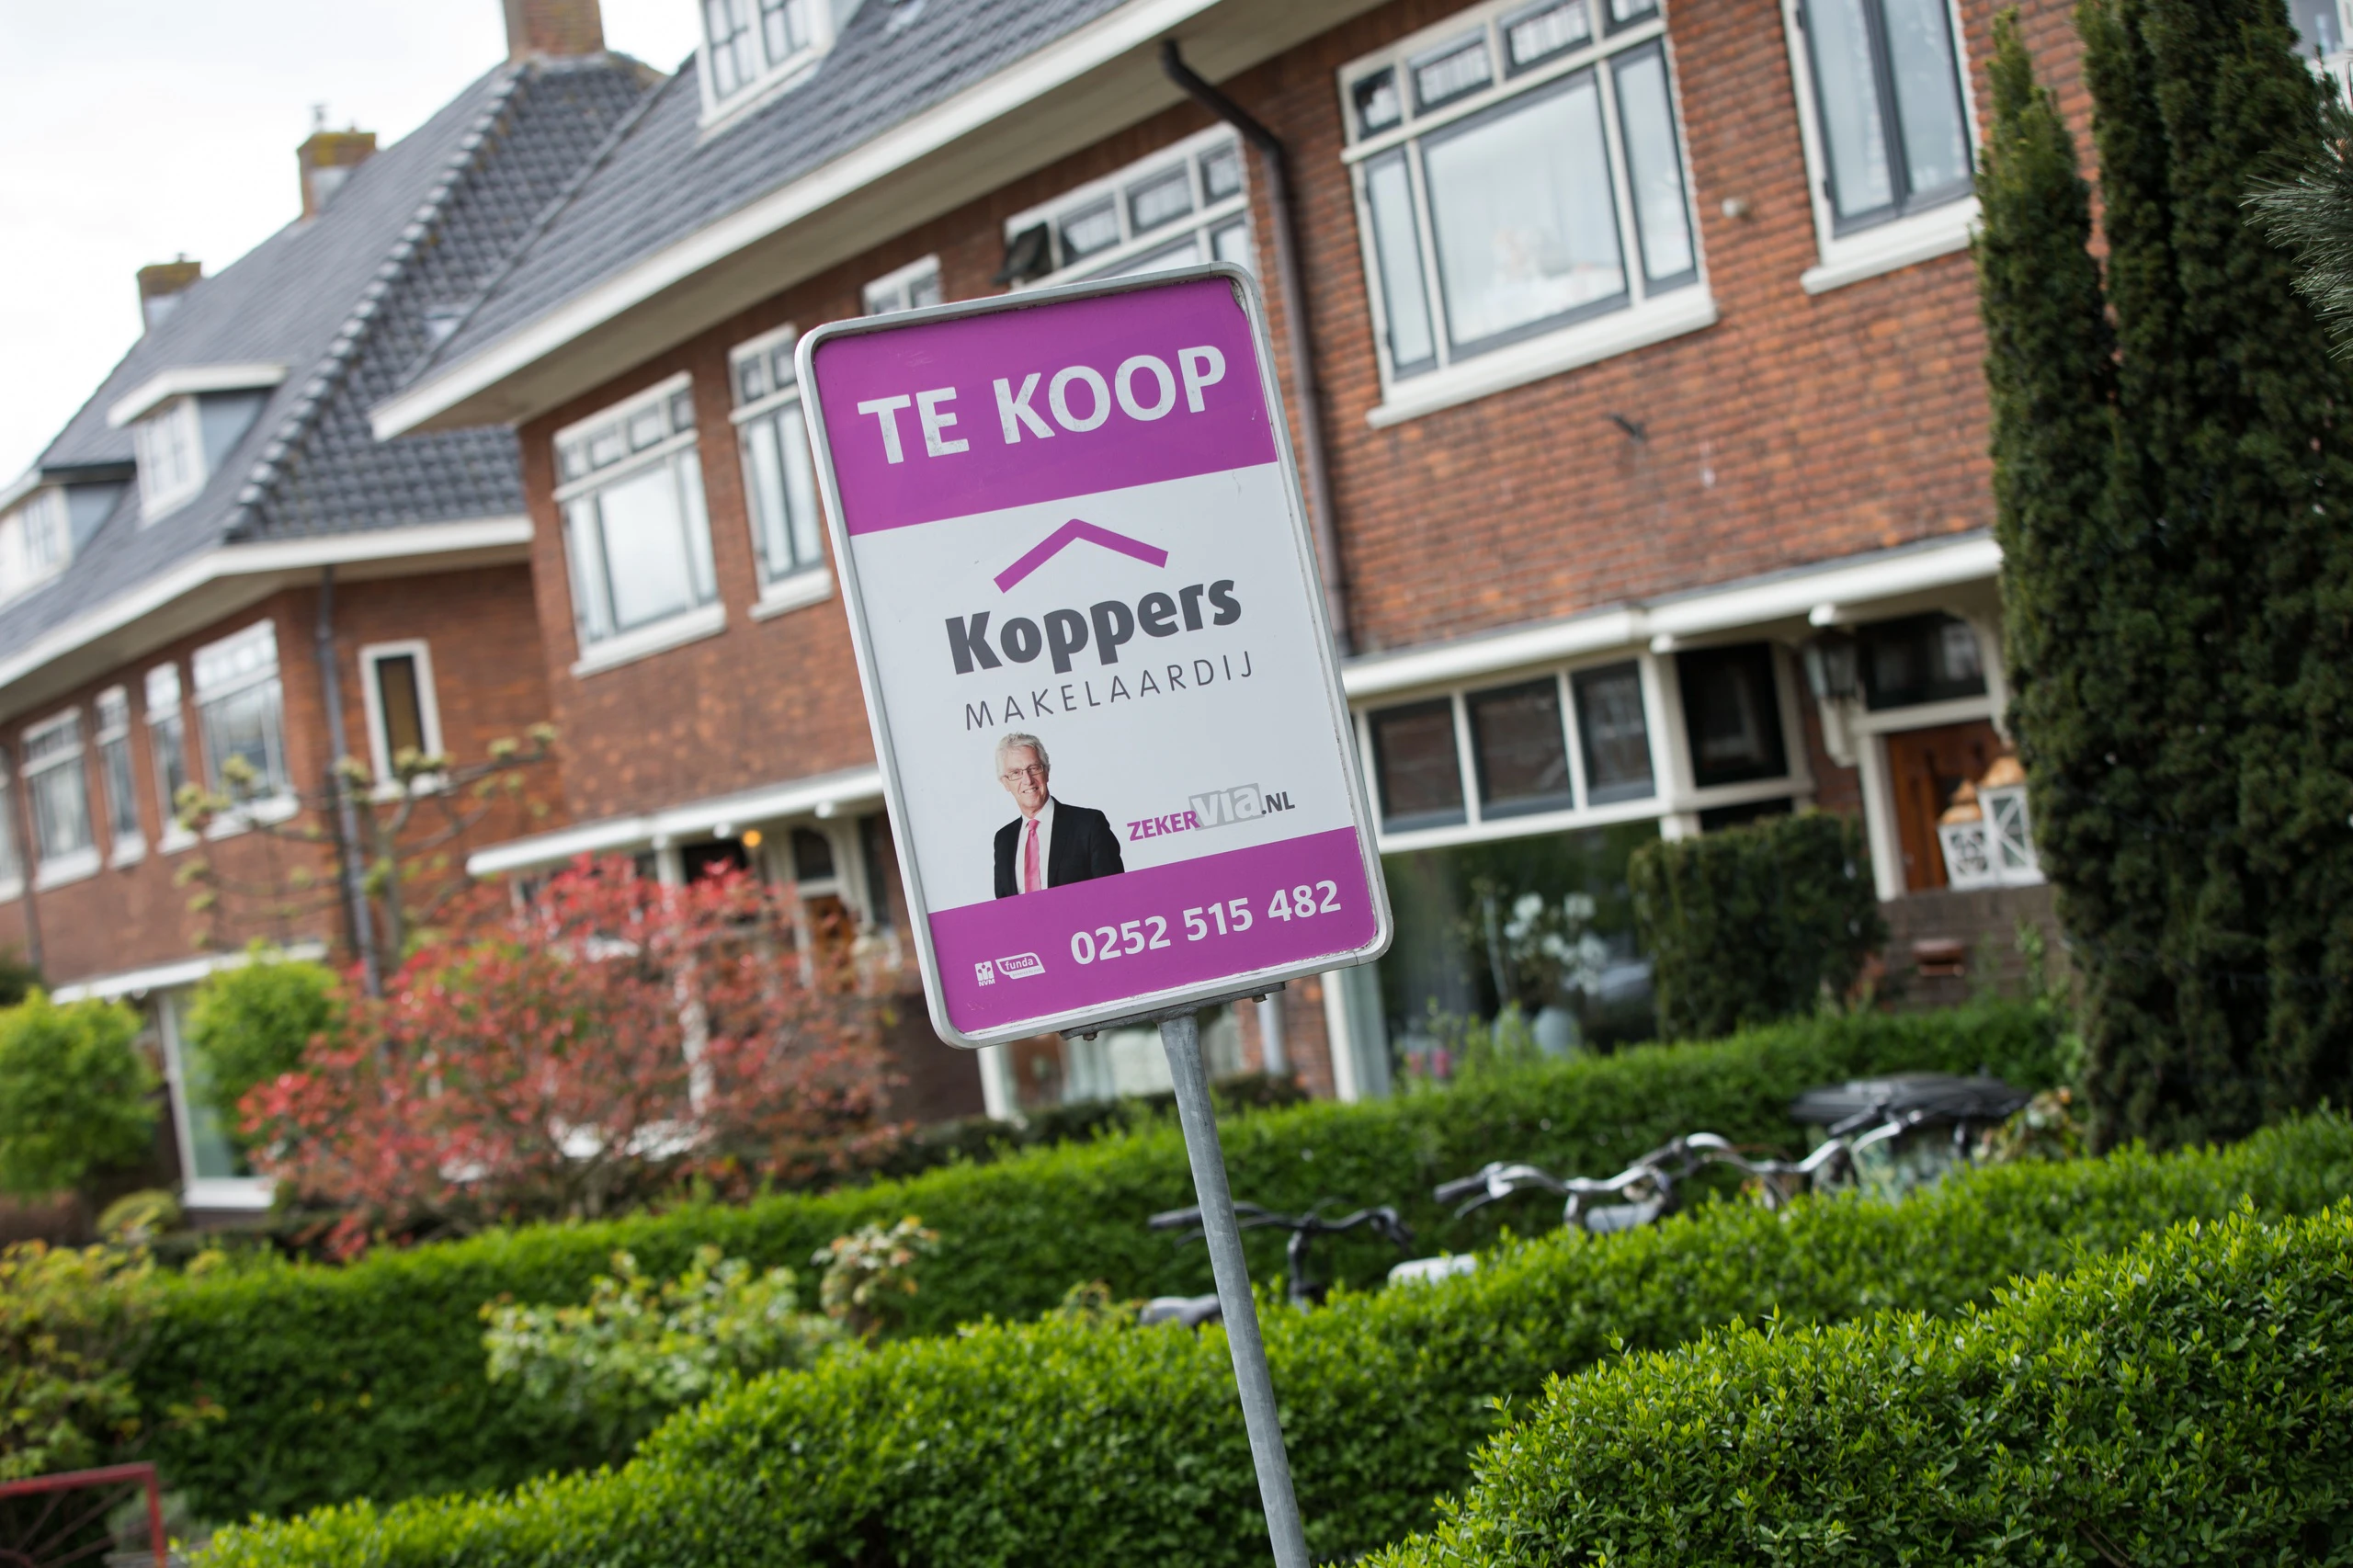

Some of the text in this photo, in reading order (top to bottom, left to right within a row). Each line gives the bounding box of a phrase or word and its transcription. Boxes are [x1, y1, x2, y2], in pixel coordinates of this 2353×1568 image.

[858, 345, 1226, 464] TE KOOP
[945, 580, 1242, 675] Koppers
[965, 651, 1254, 731] MAKELAARDIJ
[1070, 880, 1342, 965] 0252 515 482
[978, 978, 995, 987] NVM
[1005, 957, 1034, 971] funda
